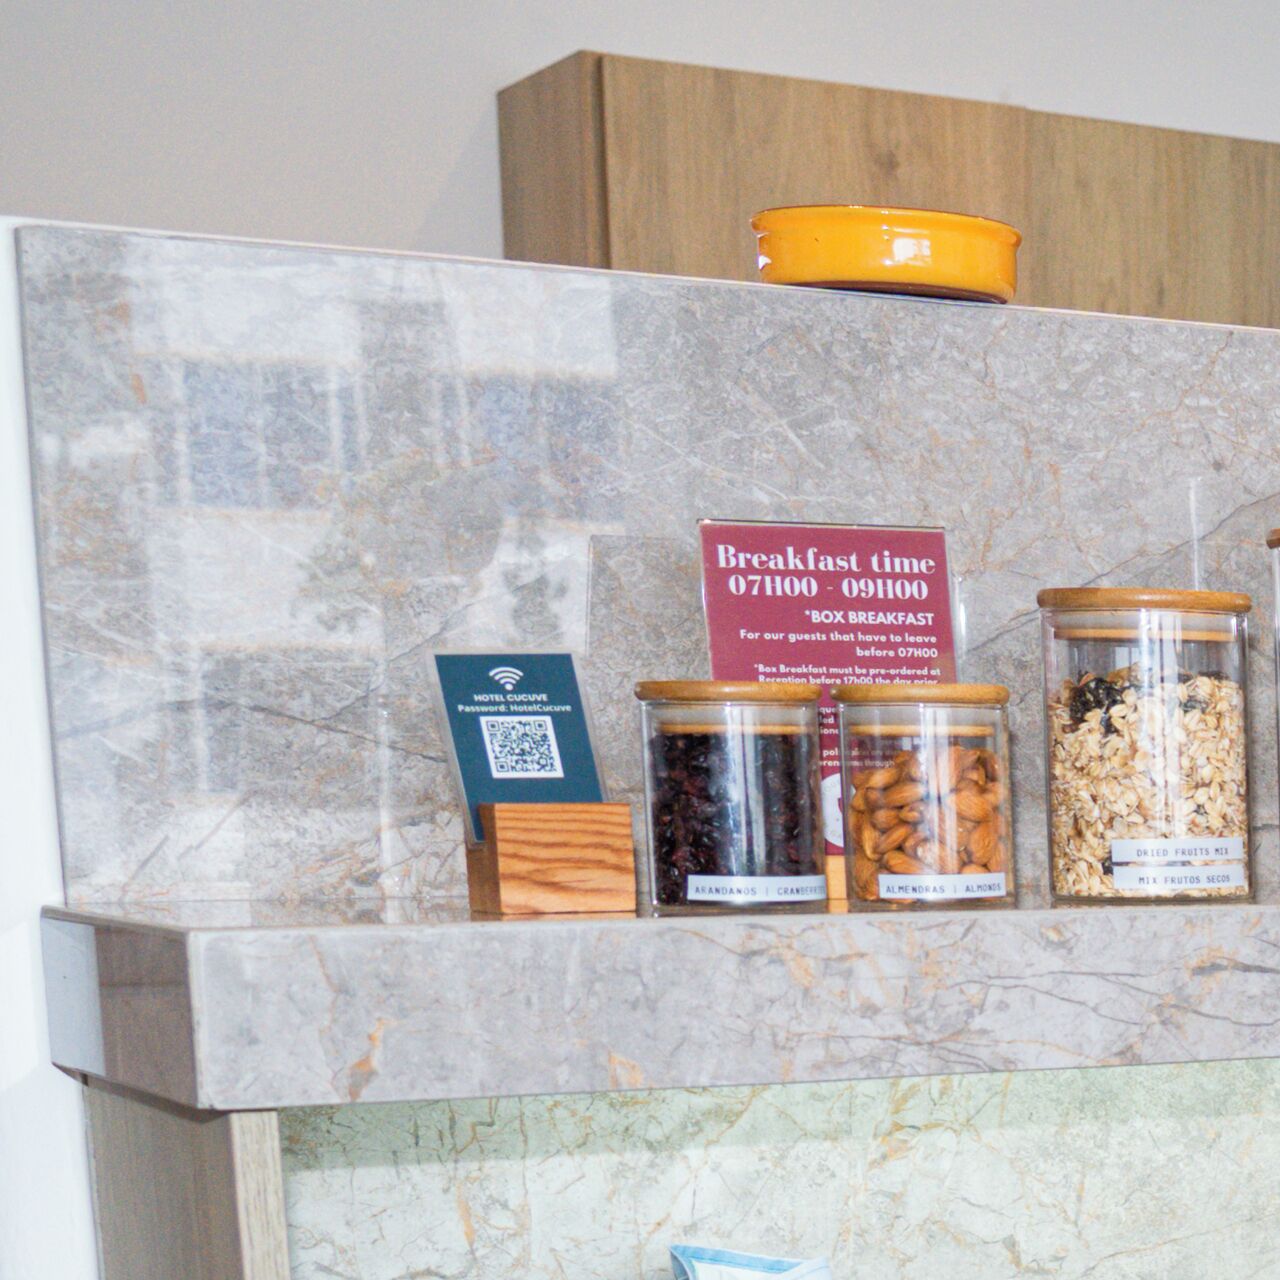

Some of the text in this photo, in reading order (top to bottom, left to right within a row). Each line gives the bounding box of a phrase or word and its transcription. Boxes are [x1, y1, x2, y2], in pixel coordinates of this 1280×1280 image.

[717, 544, 936, 575] Breakfast time
[728, 574, 818, 597] 07H00
[841, 577, 929, 600] 09H00
[849, 611, 934, 625] BREAKFAST
[739, 629, 937, 643] For our guests that have to leave
[856, 647, 938, 658] before 07H00
[779, 664, 827, 674] Breakfast
[829, 665, 854, 674] must
[855, 665, 867, 674] be
[868, 665, 930, 677] pre-ordered
[931, 668, 941, 676] at
[758, 675, 807, 684] Reception
[809, 676, 841, 684] before
[473, 694, 548, 702] HOTEL CUCUVE
[510, 704, 572, 712] HotelCucuve
[1136, 847, 1229, 857] DRIED FRUITS MIX
[1139, 874, 1231, 885] MIX FRUTOS SECOS
[886, 885, 945, 894] ALMENDRAS
